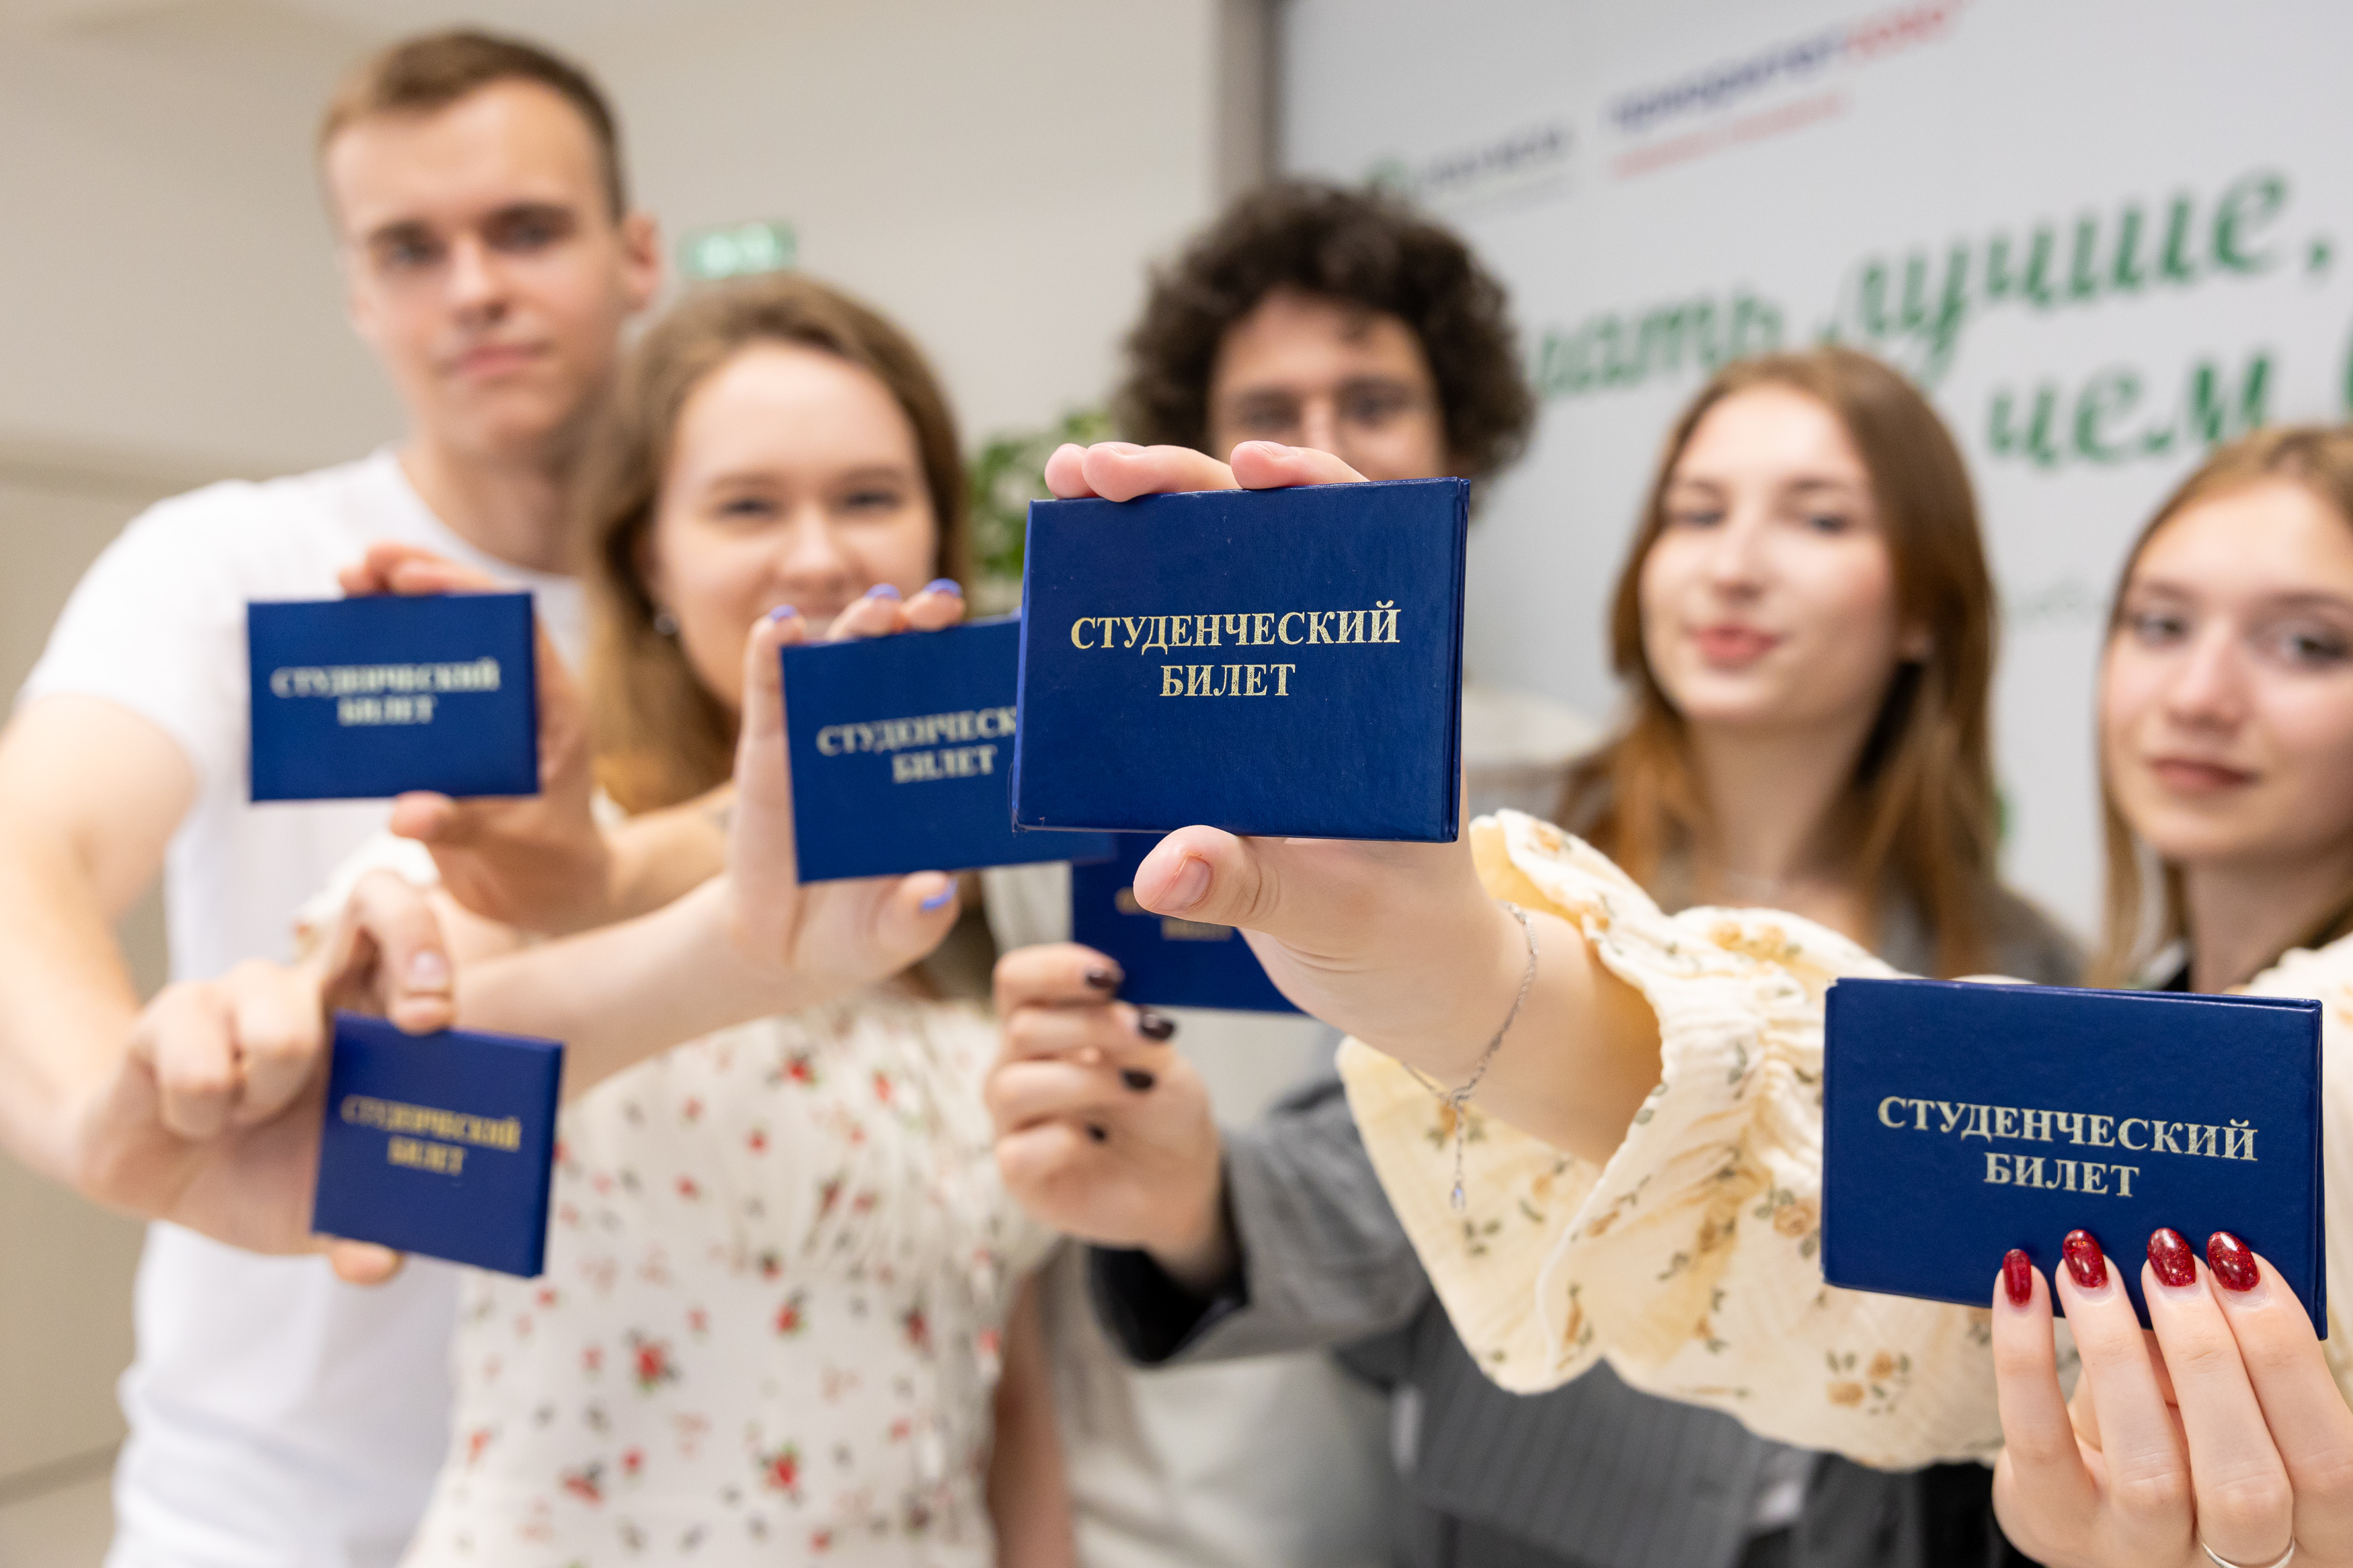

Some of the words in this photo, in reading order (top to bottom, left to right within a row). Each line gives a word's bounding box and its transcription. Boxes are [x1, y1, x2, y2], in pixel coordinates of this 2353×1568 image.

[1070, 600, 1402, 655] СТУДЕНЧЕСКИЙ
[1159, 664, 1296, 696] БИЛЕТ
[815, 706, 1017, 757] СТУДЕНЧЕСК
[891, 743, 998, 784] БИЛЕТ
[1877, 1096, 2259, 1161] СТУДЕНЧЕСКИЙ
[1983, 1151, 2140, 1198] БИЛЕТ
